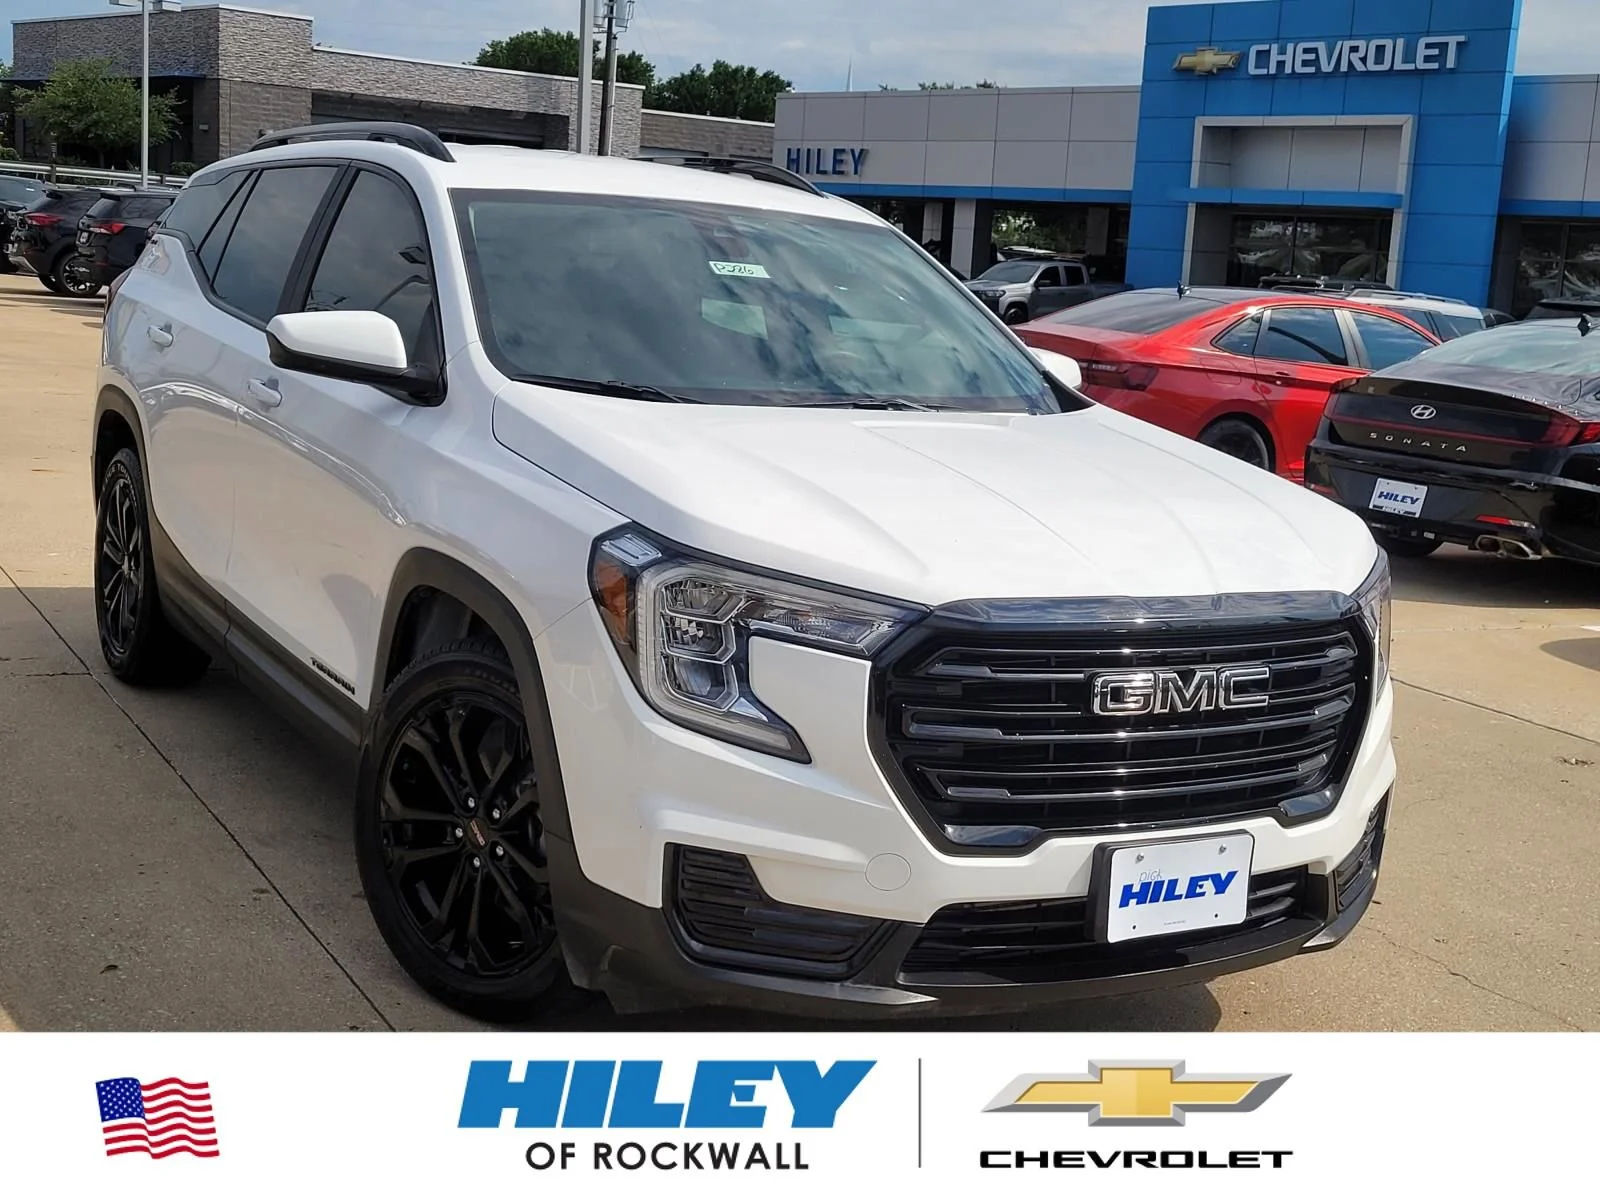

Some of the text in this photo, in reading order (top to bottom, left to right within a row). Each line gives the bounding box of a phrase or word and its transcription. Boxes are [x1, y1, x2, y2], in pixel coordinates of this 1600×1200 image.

[1247, 35, 1466, 76] CHEVROLET
[786, 147, 869, 175] HILEY
[1369, 432, 1466, 452] SONATA
[1378, 491, 1420, 505] HILEY
[1092, 667, 1270, 716] GMC
[1118, 870, 1239, 909] HILEY
